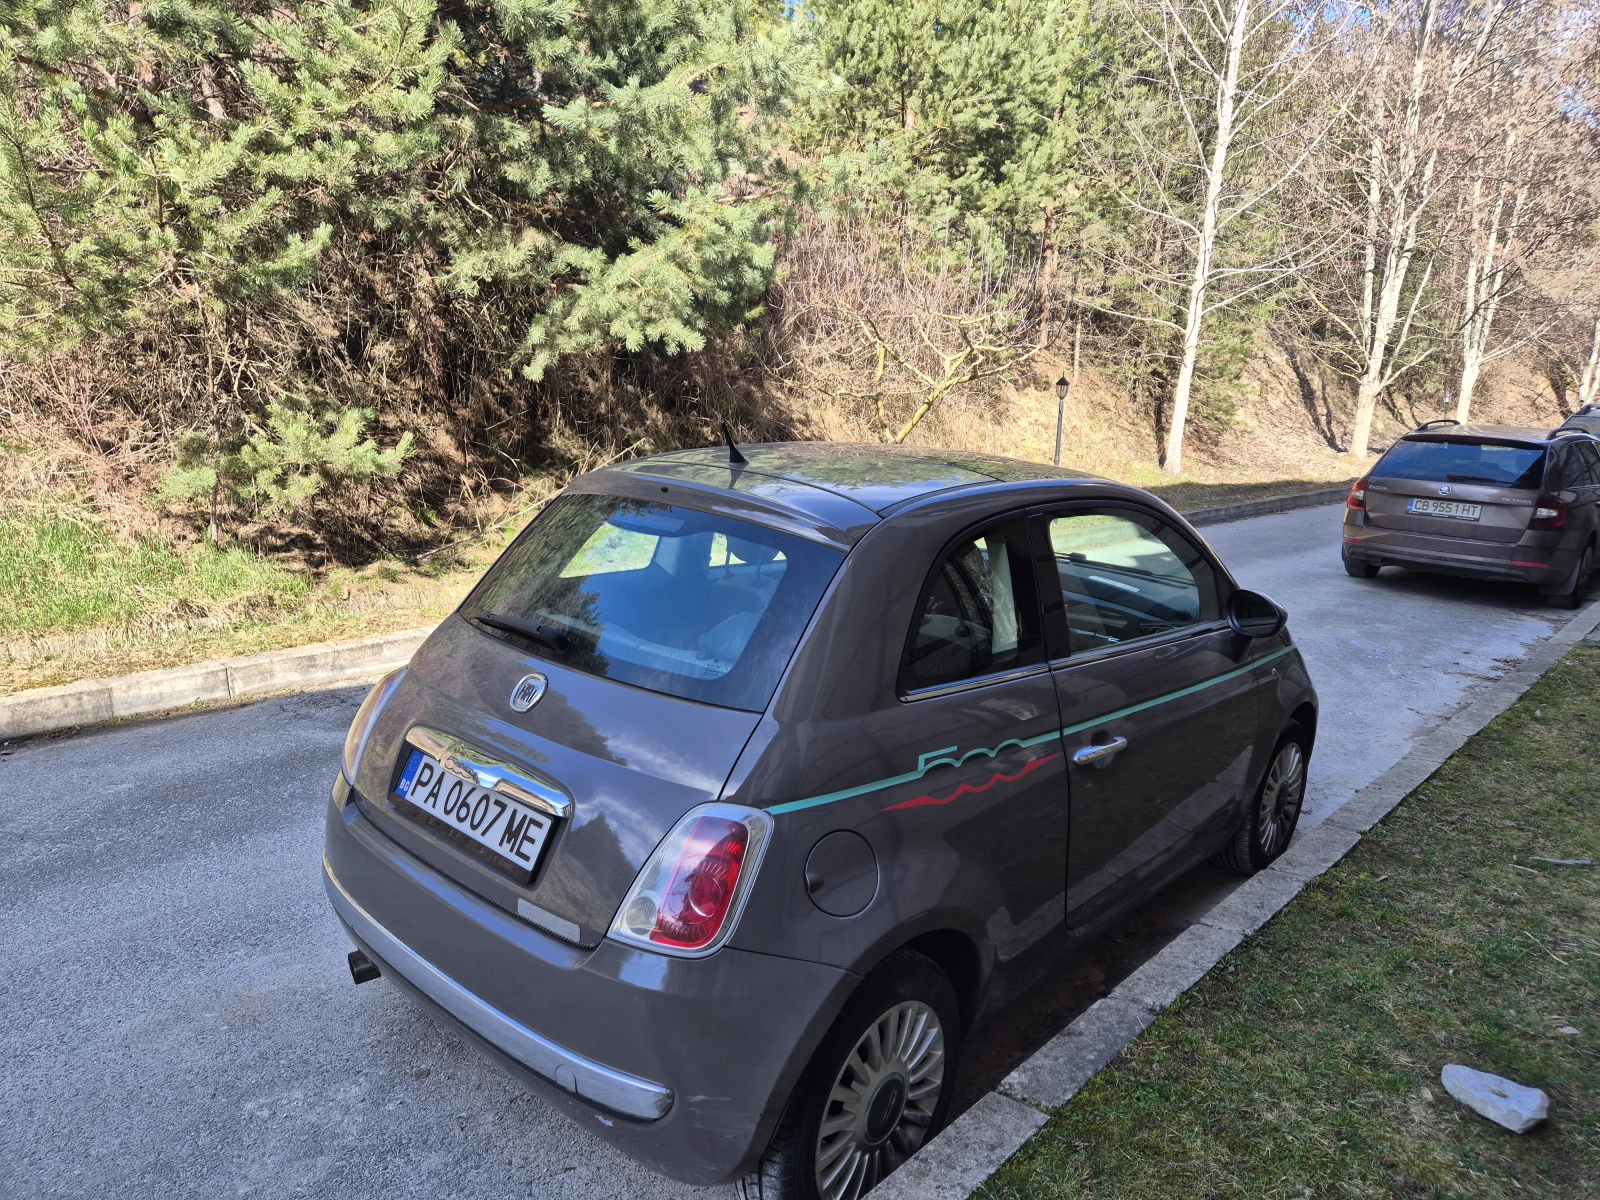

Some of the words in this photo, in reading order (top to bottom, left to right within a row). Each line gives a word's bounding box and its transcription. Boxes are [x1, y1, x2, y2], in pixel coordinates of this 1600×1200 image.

[1414, 500, 1429, 511] CB
[1432, 501, 1460, 514] 9551
[1461, 504, 1479, 516] HT
[399, 778, 410, 792] BG
[410, 762, 446, 809] PA
[443, 780, 508, 837] 0607
[498, 808, 544, 863] ME
